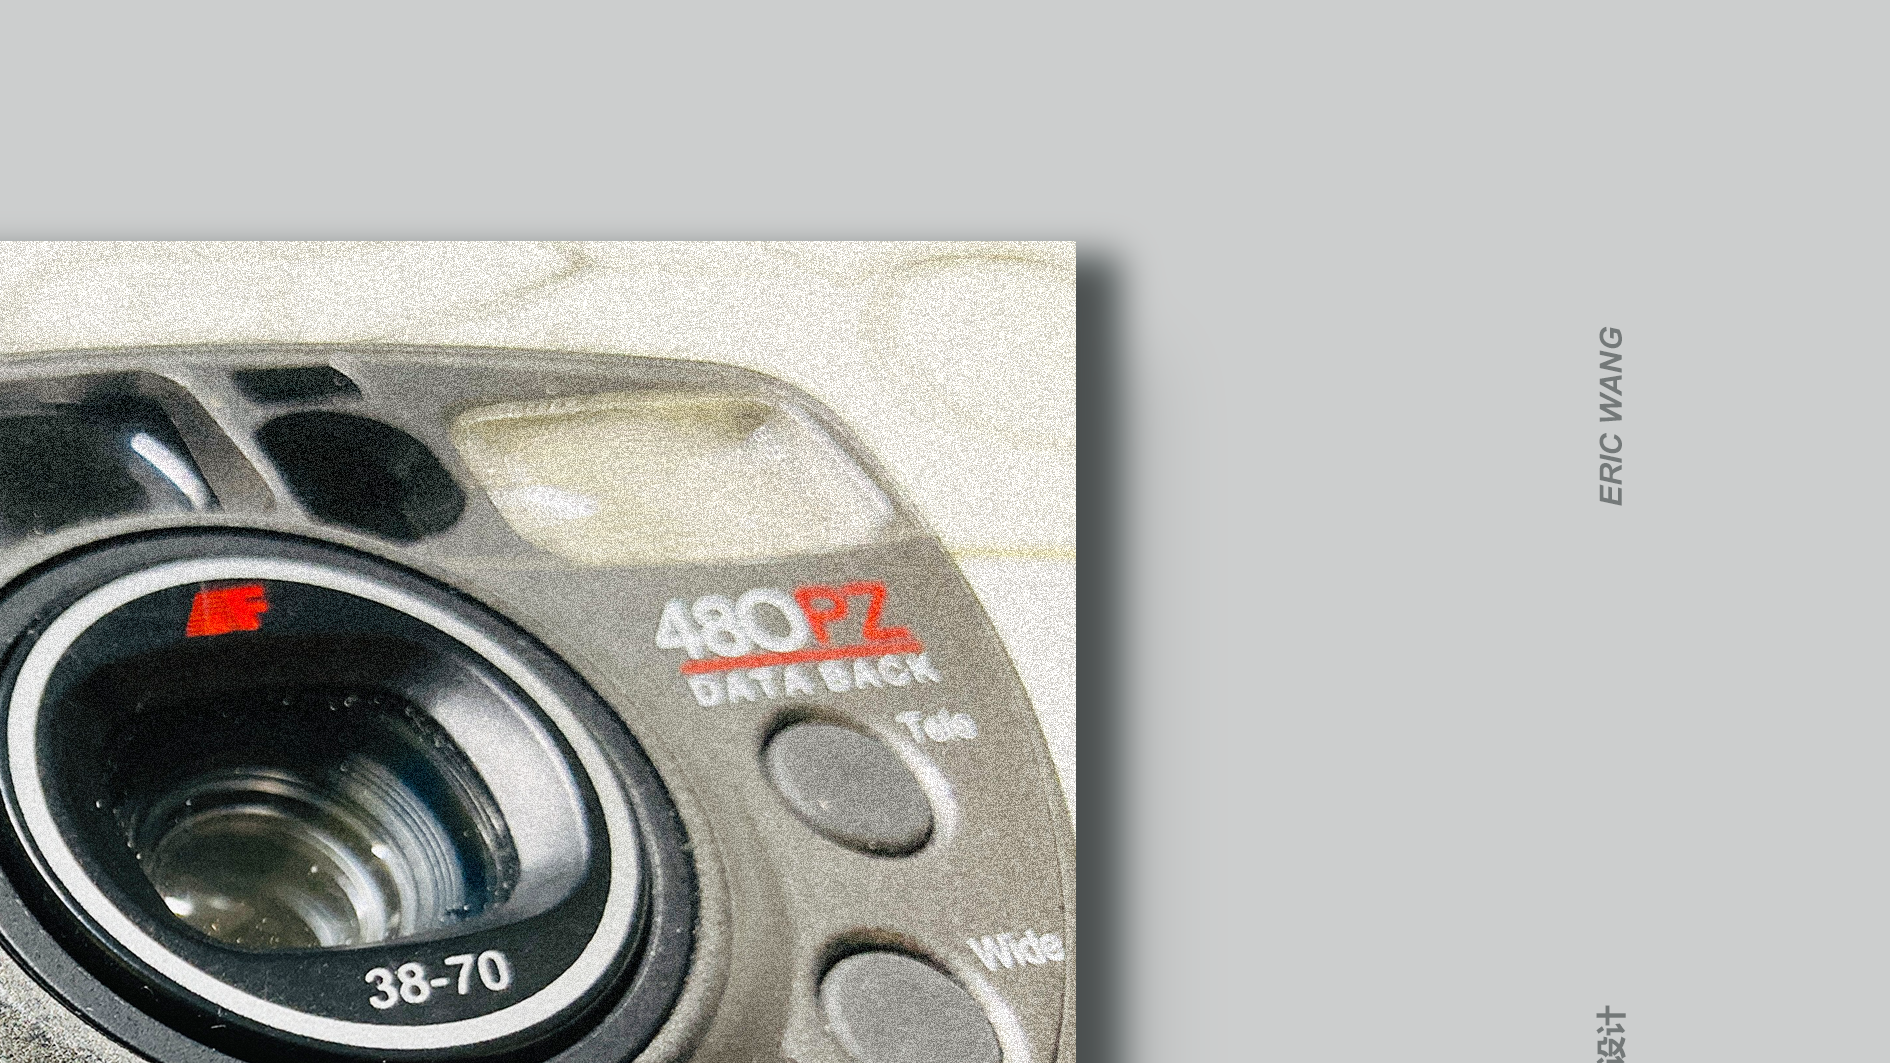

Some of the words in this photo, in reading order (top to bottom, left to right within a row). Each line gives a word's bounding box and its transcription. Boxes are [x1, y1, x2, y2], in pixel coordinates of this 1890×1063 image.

[688, 664, 816, 707] DATA
[818, 653, 943, 694] BACK
[965, 928, 1066, 972] Wide
[362, 947, 513, 1012] 38-70
